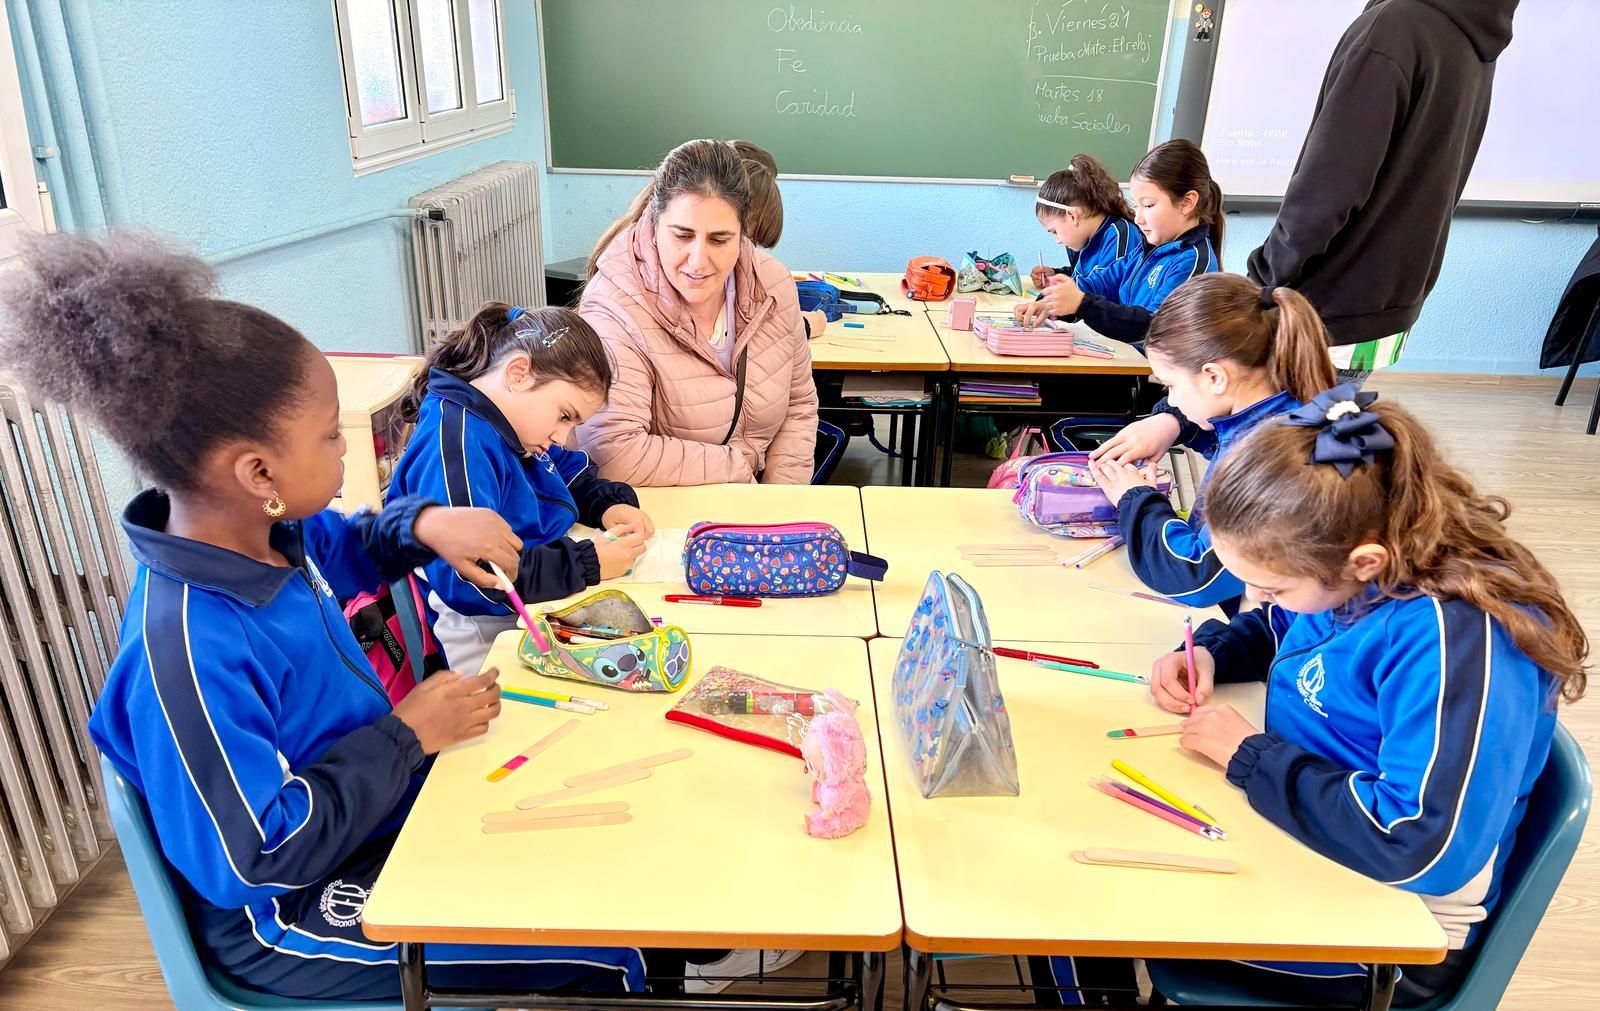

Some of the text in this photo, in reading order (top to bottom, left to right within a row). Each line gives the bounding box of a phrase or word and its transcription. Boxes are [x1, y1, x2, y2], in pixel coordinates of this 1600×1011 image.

[1046, 9, 1107, 35] Viernes
[1109, 10, 1130, 29] 21
[1032, 42, 1076, 63] Prueba
[1125, 31, 1152, 63] reloj
[773, 48, 808, 73] Fe
[775, 88, 856, 118] Caridad
[1034, 81, 1104, 102] Martes 18
[1071, 112, 1131, 135] Sociales
